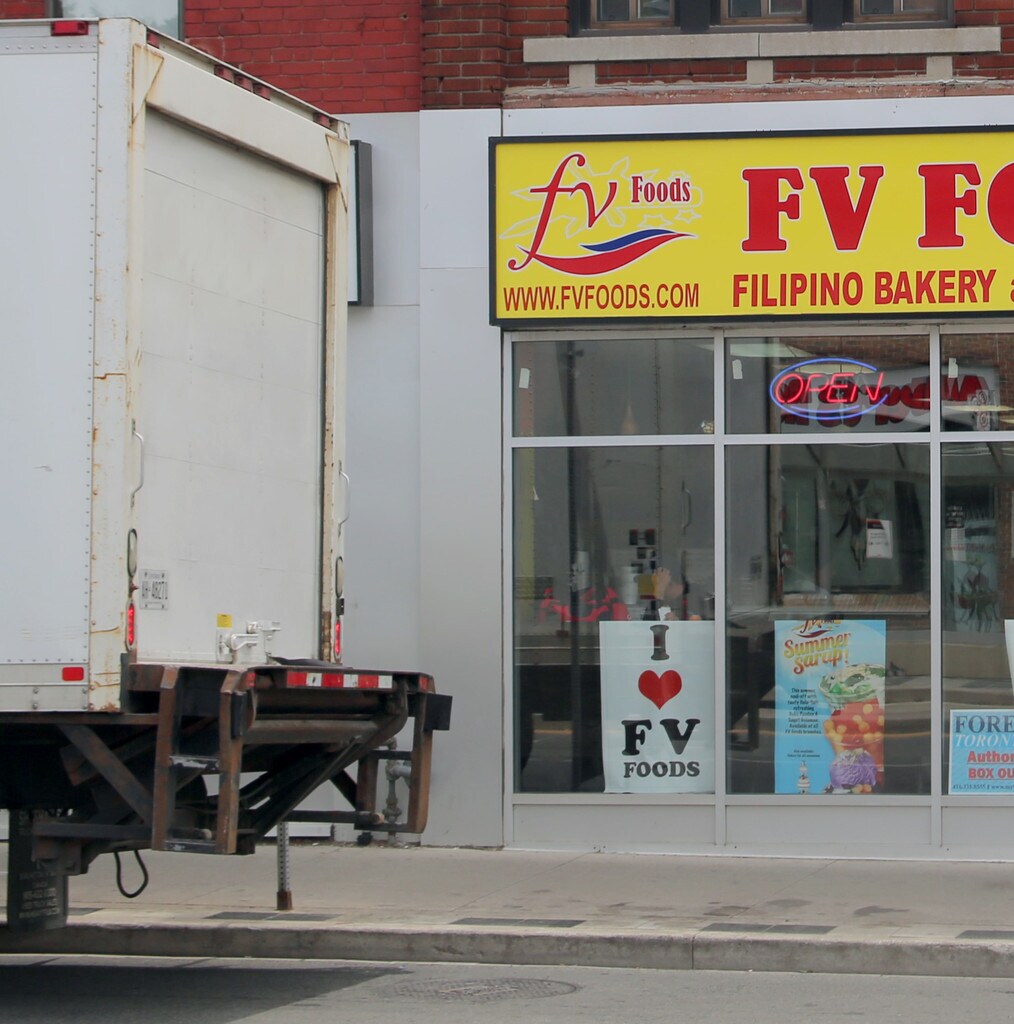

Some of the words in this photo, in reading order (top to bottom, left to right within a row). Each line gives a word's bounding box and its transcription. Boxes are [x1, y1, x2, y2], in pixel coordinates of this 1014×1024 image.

[630, 175, 692, 203] Foods
[741, 164, 884, 252] FV
[503, 282, 699, 311] WWW.FVFOODS.COM
[732, 271, 864, 308] FILIPINO
[873, 269, 997, 305] BAKERY
[775, 372, 885, 404] OPEN
[650, 624, 669, 661] I
[784, 632, 851, 659] Summer
[621, 718, 701, 756] FV
[623, 761, 701, 778] FOODS
[968, 767, 995, 779] BOX
